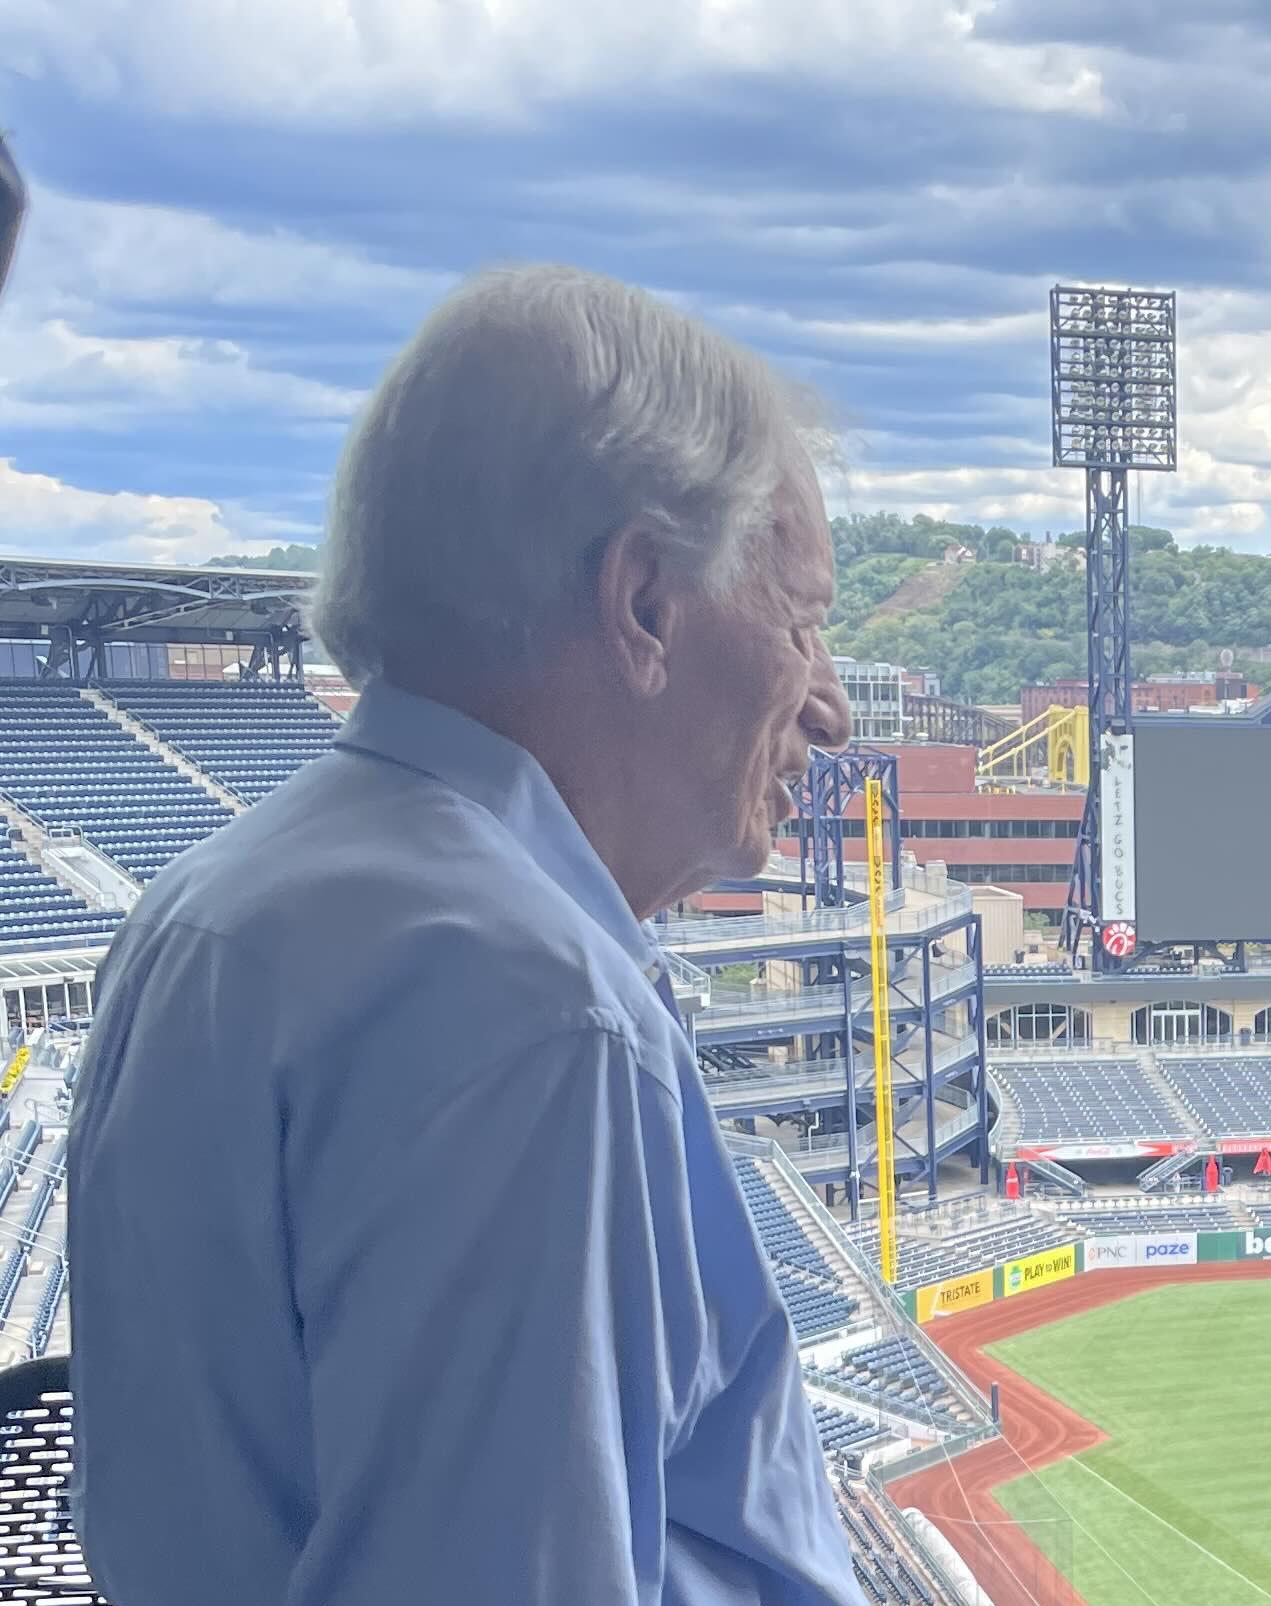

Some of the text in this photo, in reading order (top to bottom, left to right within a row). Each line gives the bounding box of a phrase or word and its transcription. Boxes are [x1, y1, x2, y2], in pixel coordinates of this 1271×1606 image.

[1097, 1246, 1128, 1259] PNC
[1146, 1243, 1189, 1259] paze
[1024, 1263, 1044, 1280] PLAY
[940, 1281, 981, 1304] TRISTATE
